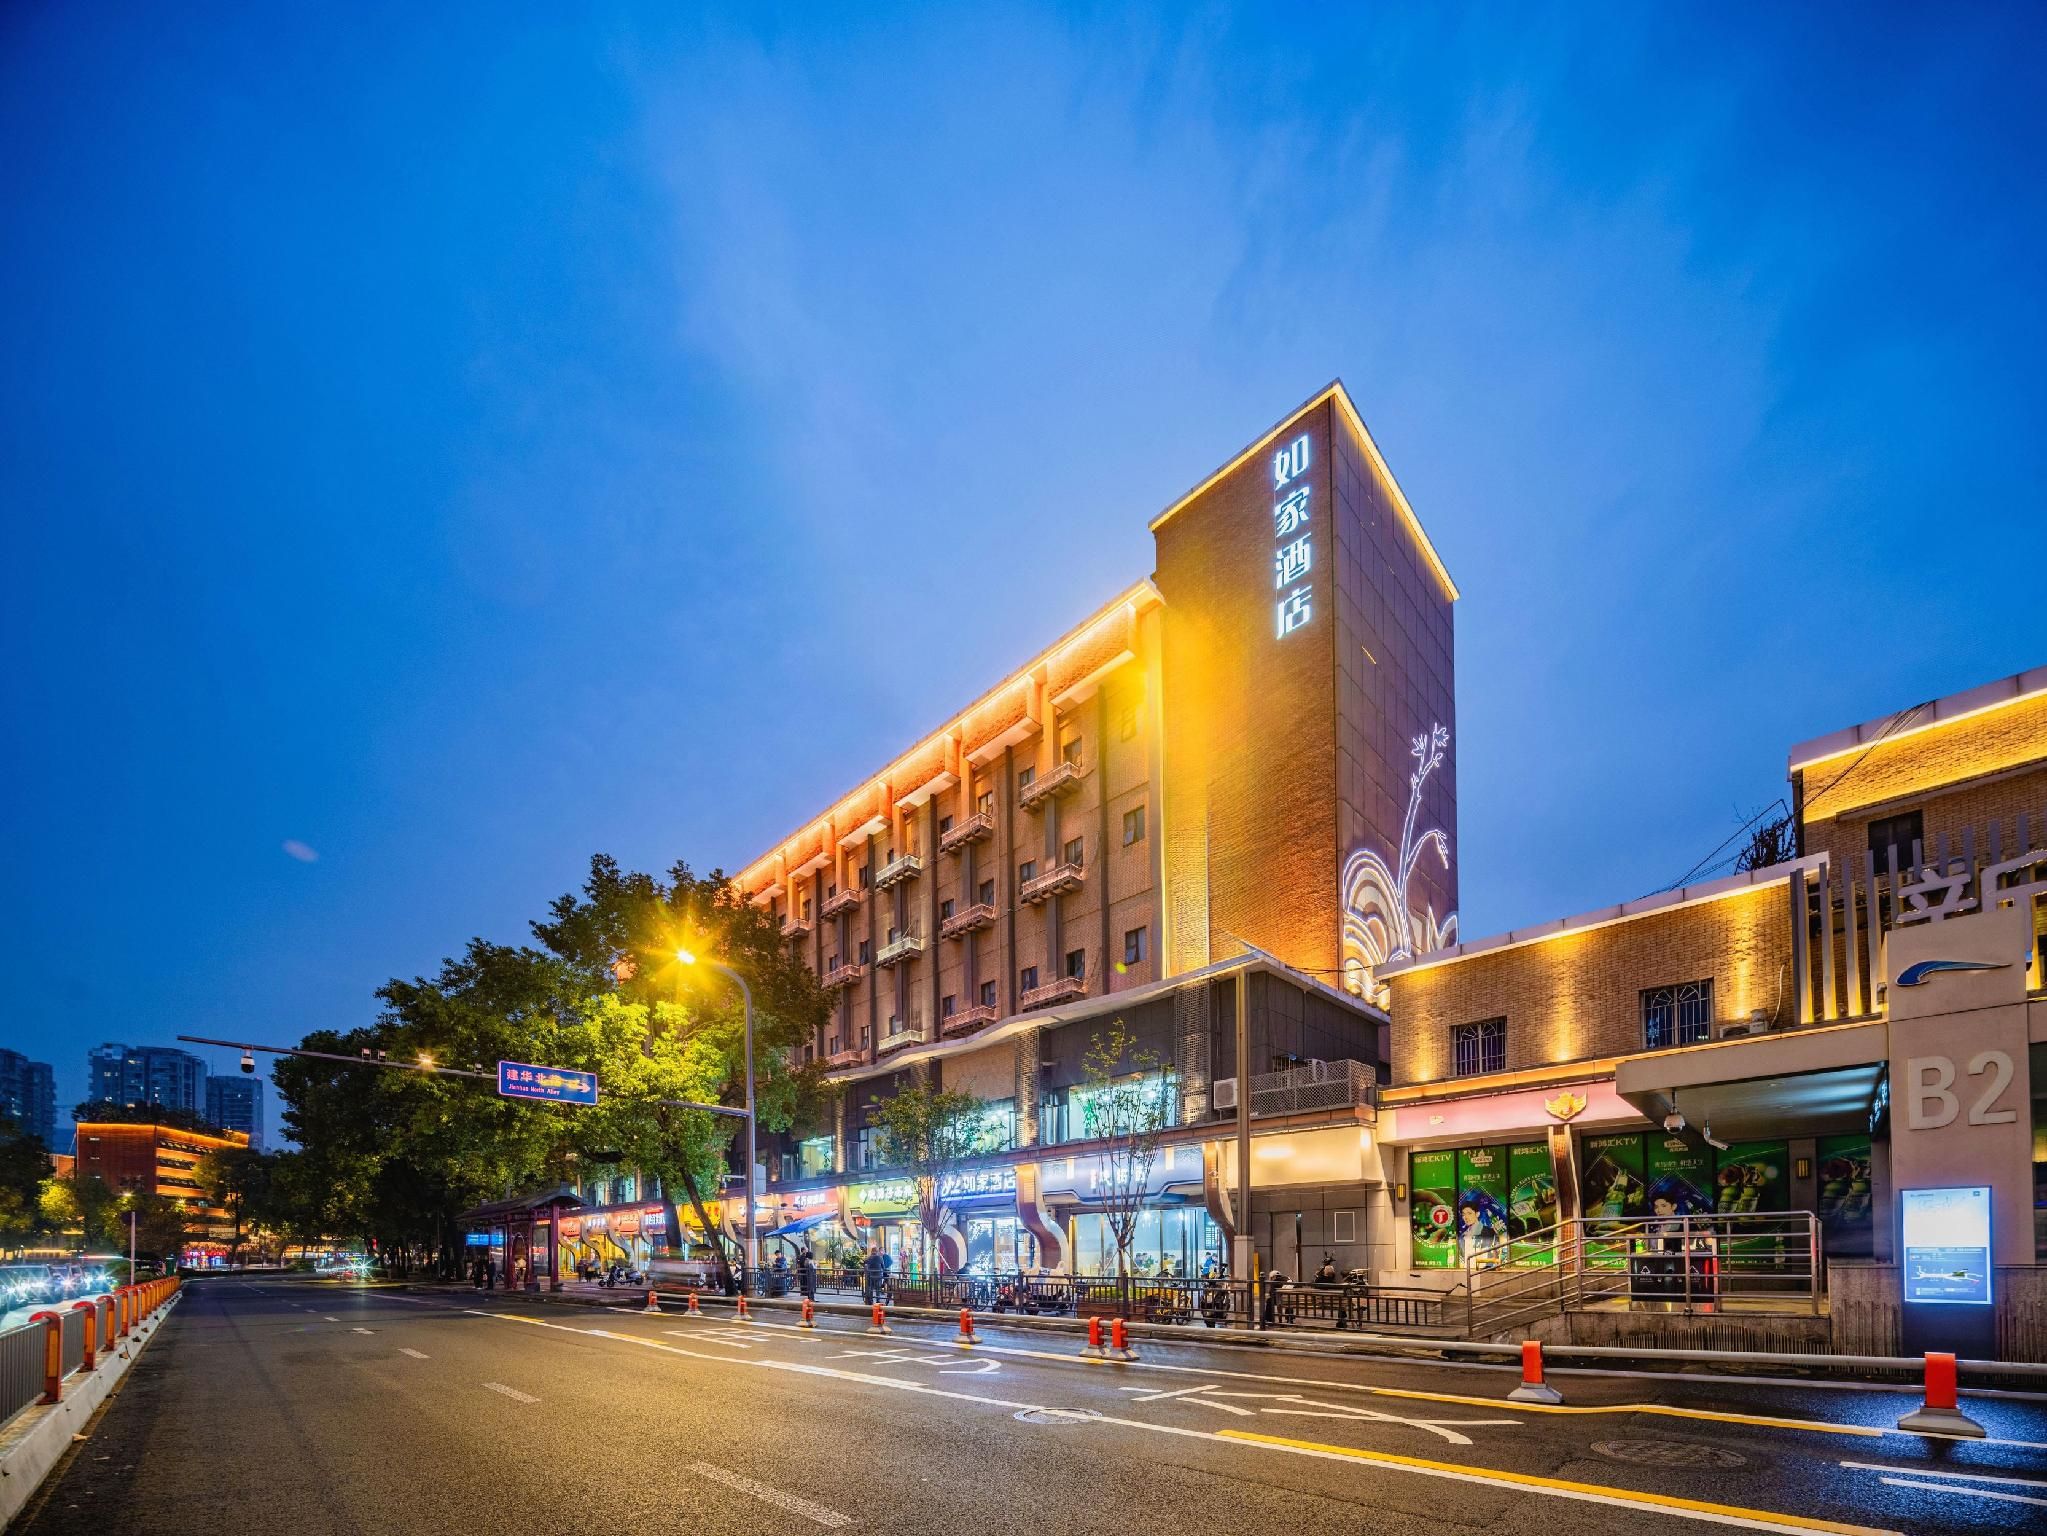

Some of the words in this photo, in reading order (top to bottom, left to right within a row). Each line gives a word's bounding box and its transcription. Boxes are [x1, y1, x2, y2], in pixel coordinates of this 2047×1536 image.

[1273, 434, 1312, 640] 如家酒店
[530, 1086, 545, 1094] North
[546, 1088, 561, 1096] Alley
[1908, 1050, 2017, 1130] B2
[963, 1171, 1016, 1192] 如家酒店
